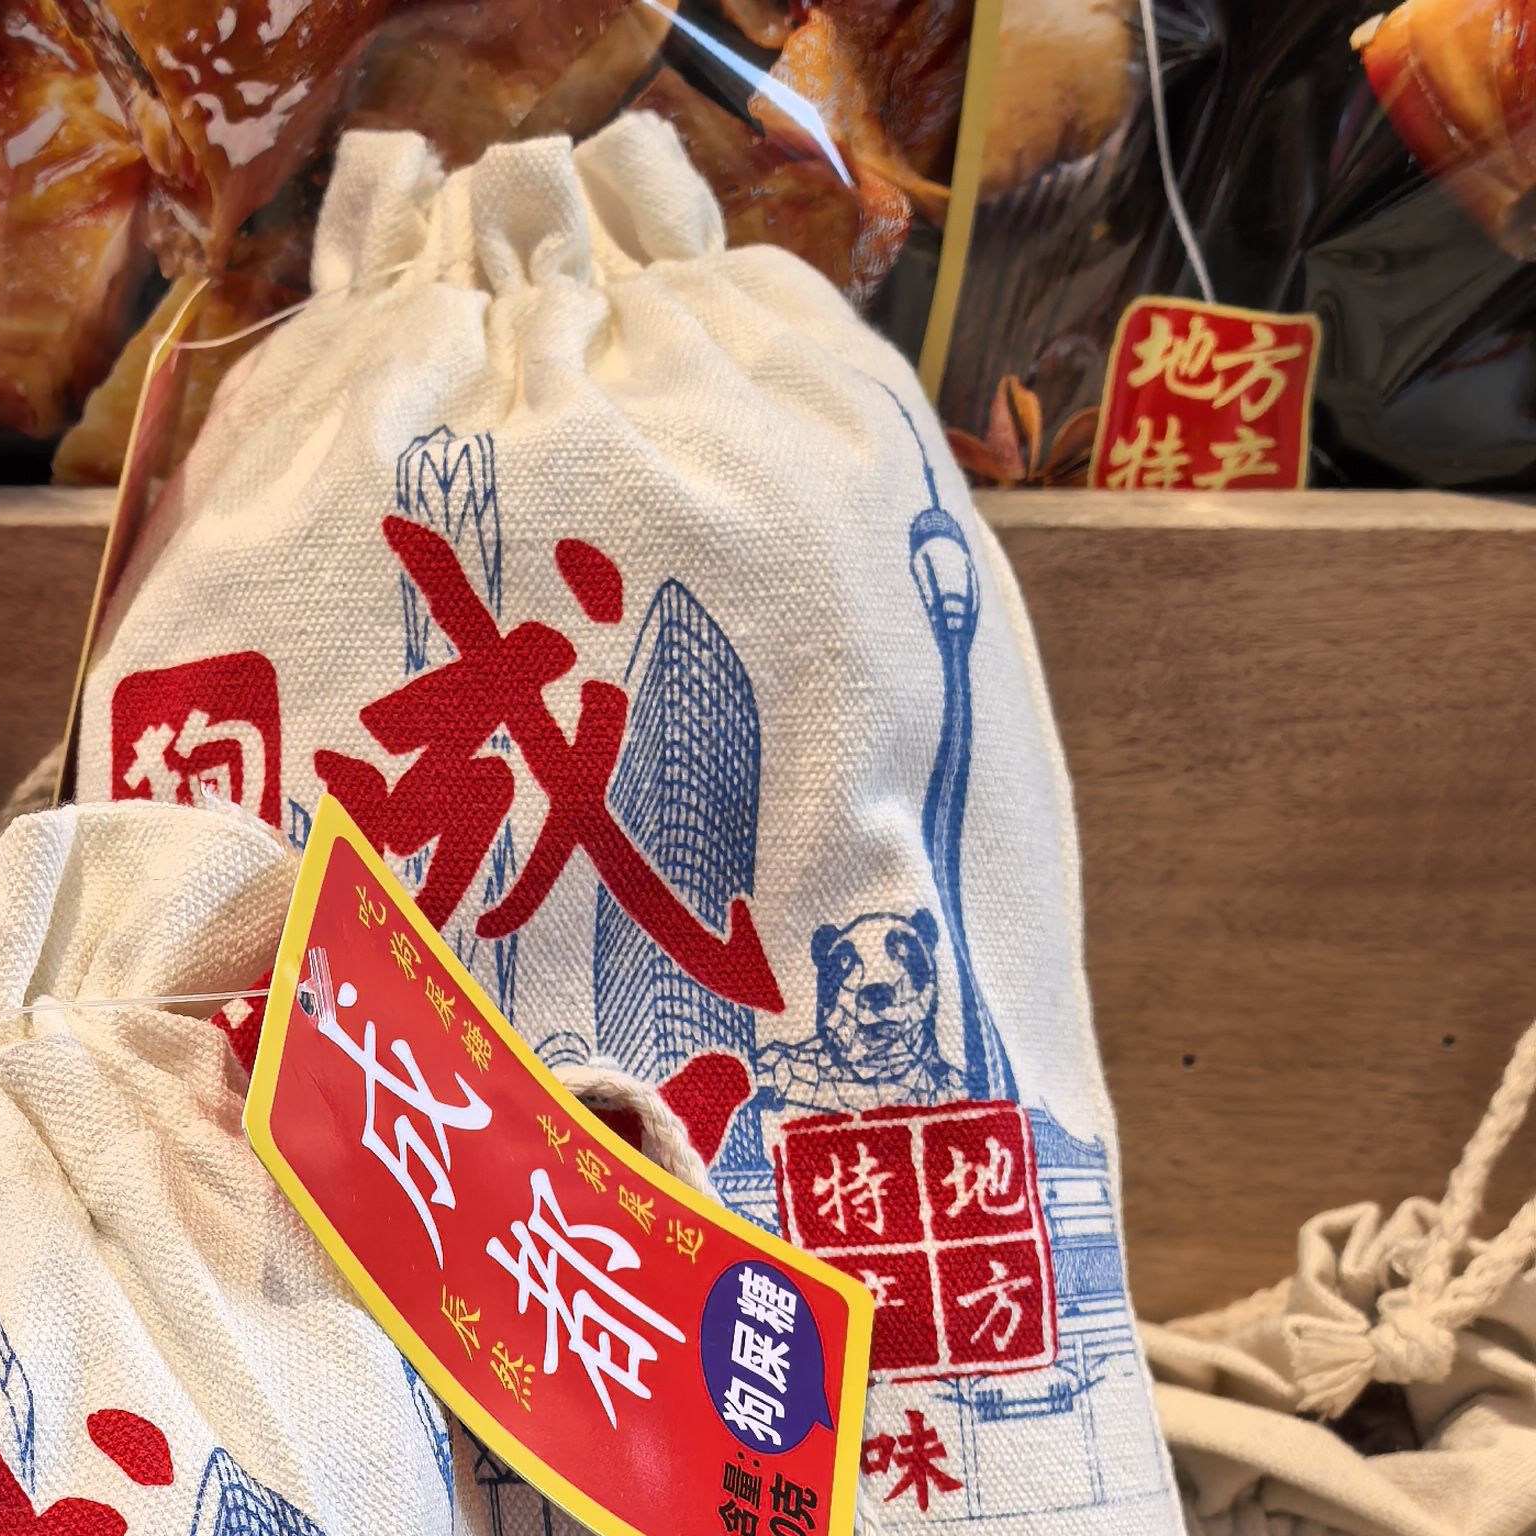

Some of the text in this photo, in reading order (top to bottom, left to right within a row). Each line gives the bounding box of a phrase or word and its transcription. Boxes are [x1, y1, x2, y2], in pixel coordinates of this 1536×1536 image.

[1127, 315, 1302, 422] 地方
[1107, 414, 1280, 490] 特产
[355, 885, 493, 1075] 吃狗屎糖
[319, 980, 687, 1430] 成都
[536, 1114, 704, 1264] 走狗屎运
[723, 1266, 798, 1448] 狗屎糖
[861, 1410, 964, 1511] 味
